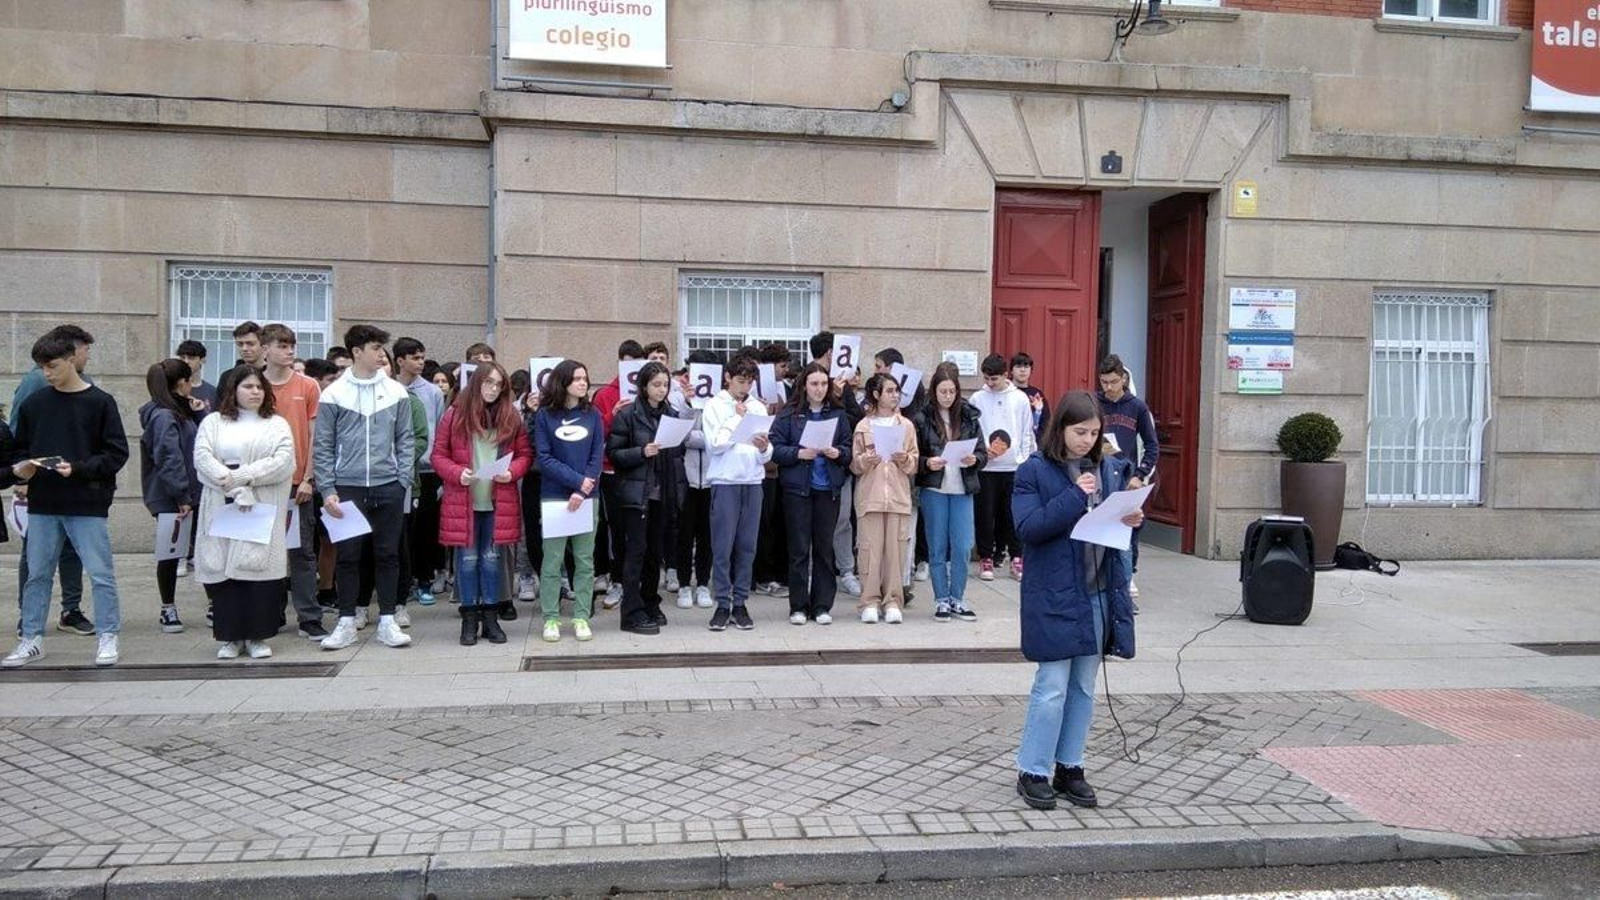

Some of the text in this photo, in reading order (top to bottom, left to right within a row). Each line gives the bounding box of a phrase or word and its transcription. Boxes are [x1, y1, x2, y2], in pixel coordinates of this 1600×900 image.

[546, 25, 631, 51] colegio
[1542, 20, 1600, 47] tale
[837, 344, 852, 368] a
[695, 374, 715, 398] a
